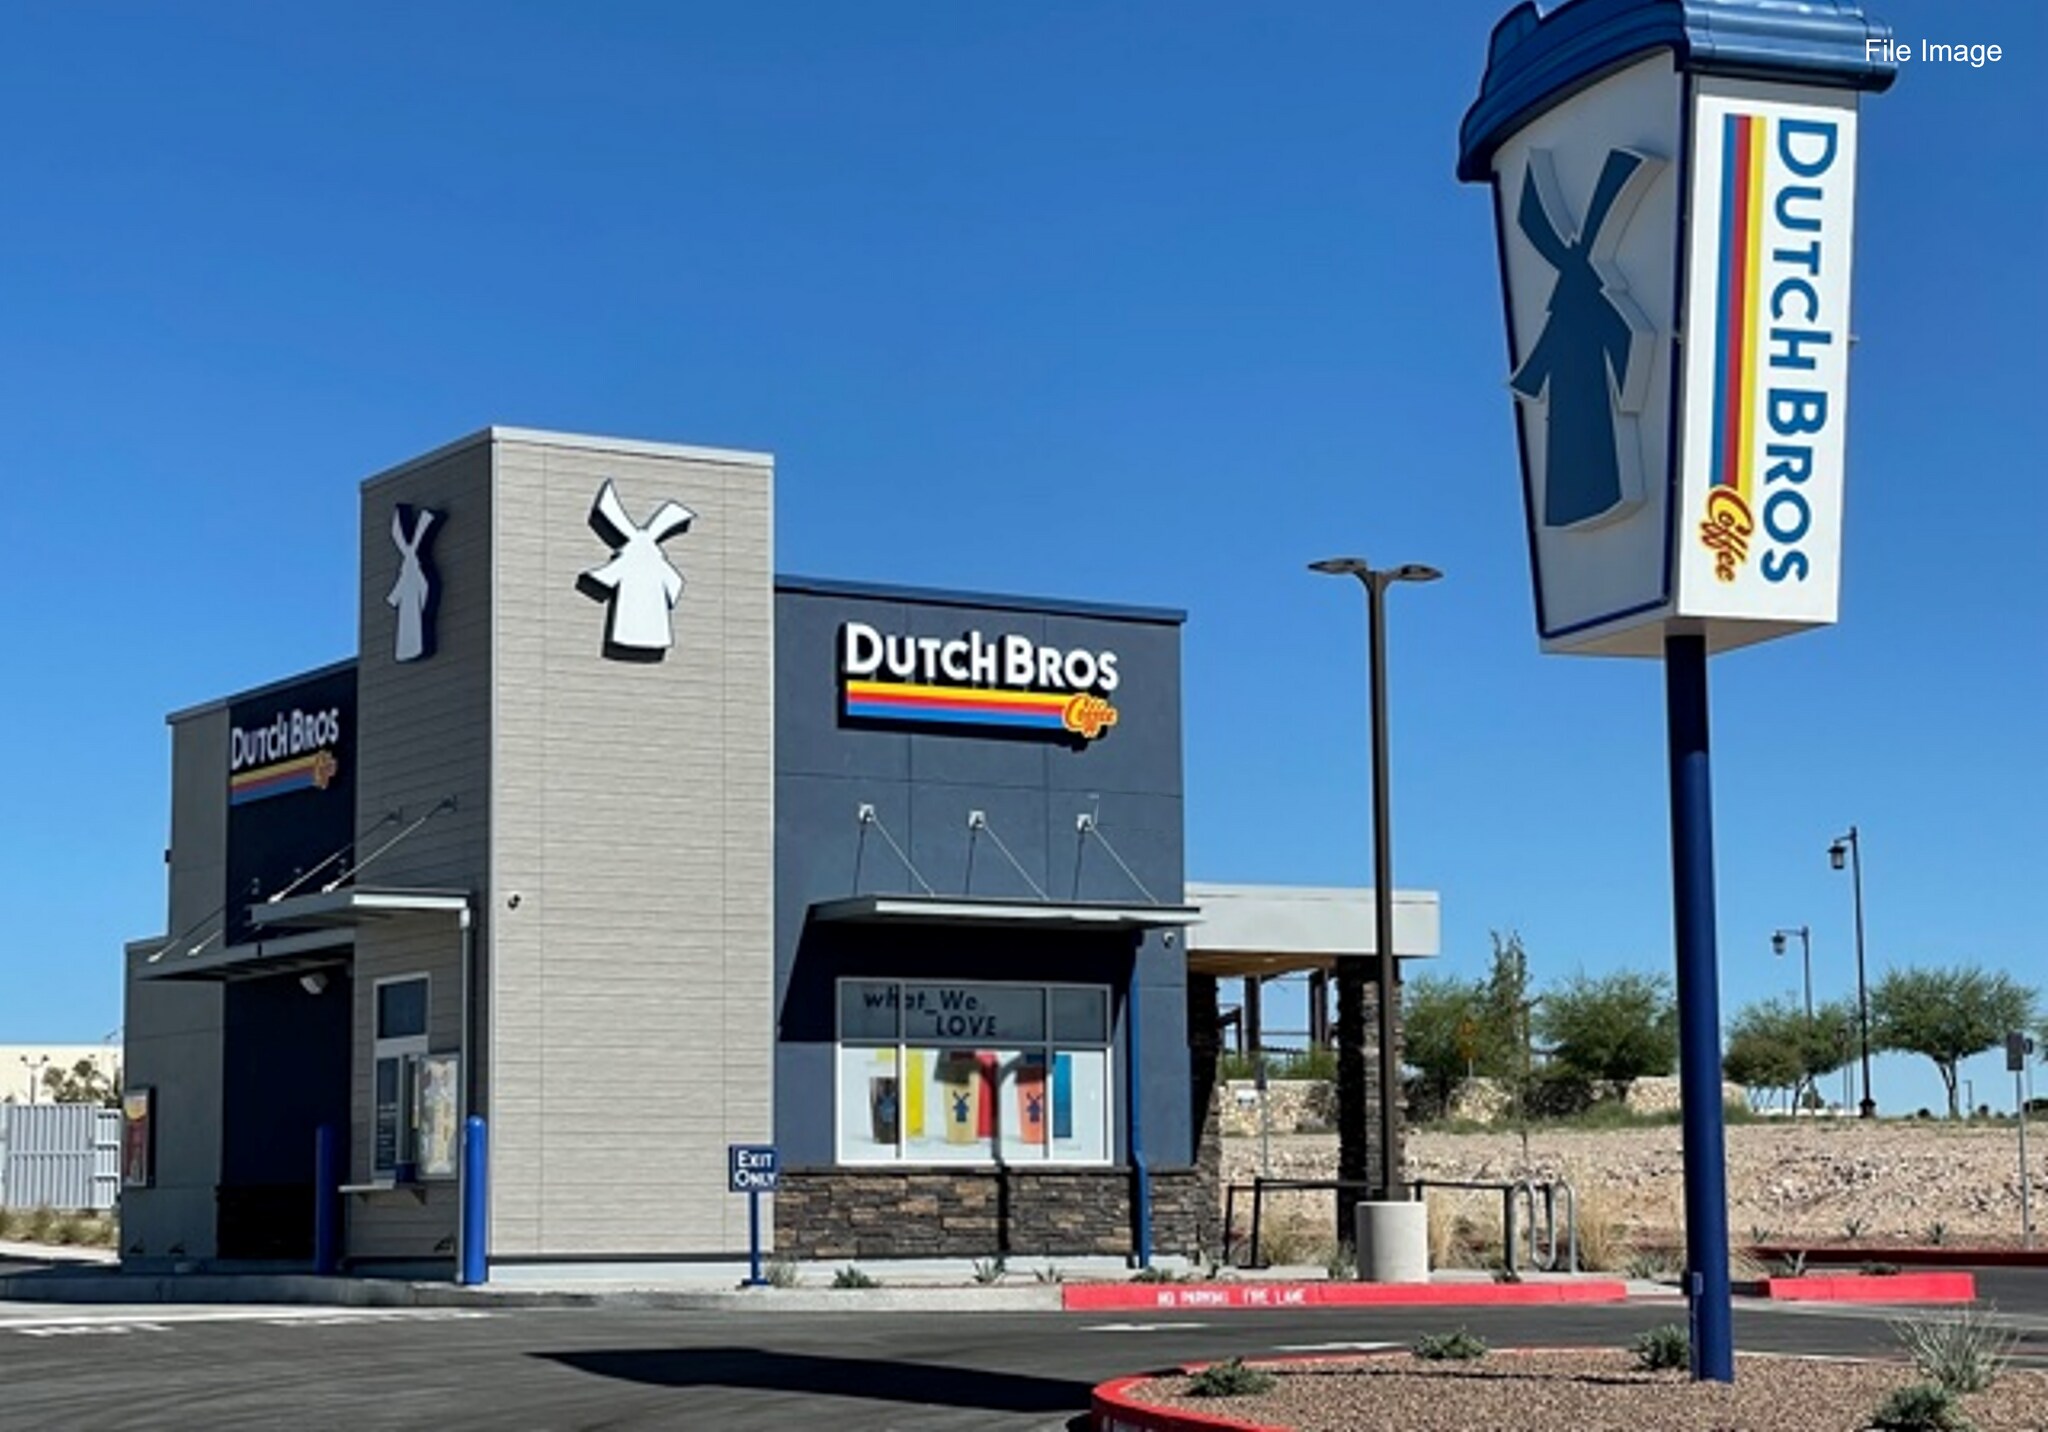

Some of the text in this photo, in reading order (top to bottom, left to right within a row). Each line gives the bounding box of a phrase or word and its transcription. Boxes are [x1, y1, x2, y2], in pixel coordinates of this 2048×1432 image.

[1760, 117, 1838, 584] DUTCH BROS
[1700, 488, 1755, 582] Coffee
[846, 621, 1119, 691] DUTCH BROS
[290, 707, 340, 754] BROS
[936, 1015, 996, 1037] LOVE
[735, 1169, 777, 1187] ONLY
[738, 1150, 772, 1167] EXIT
